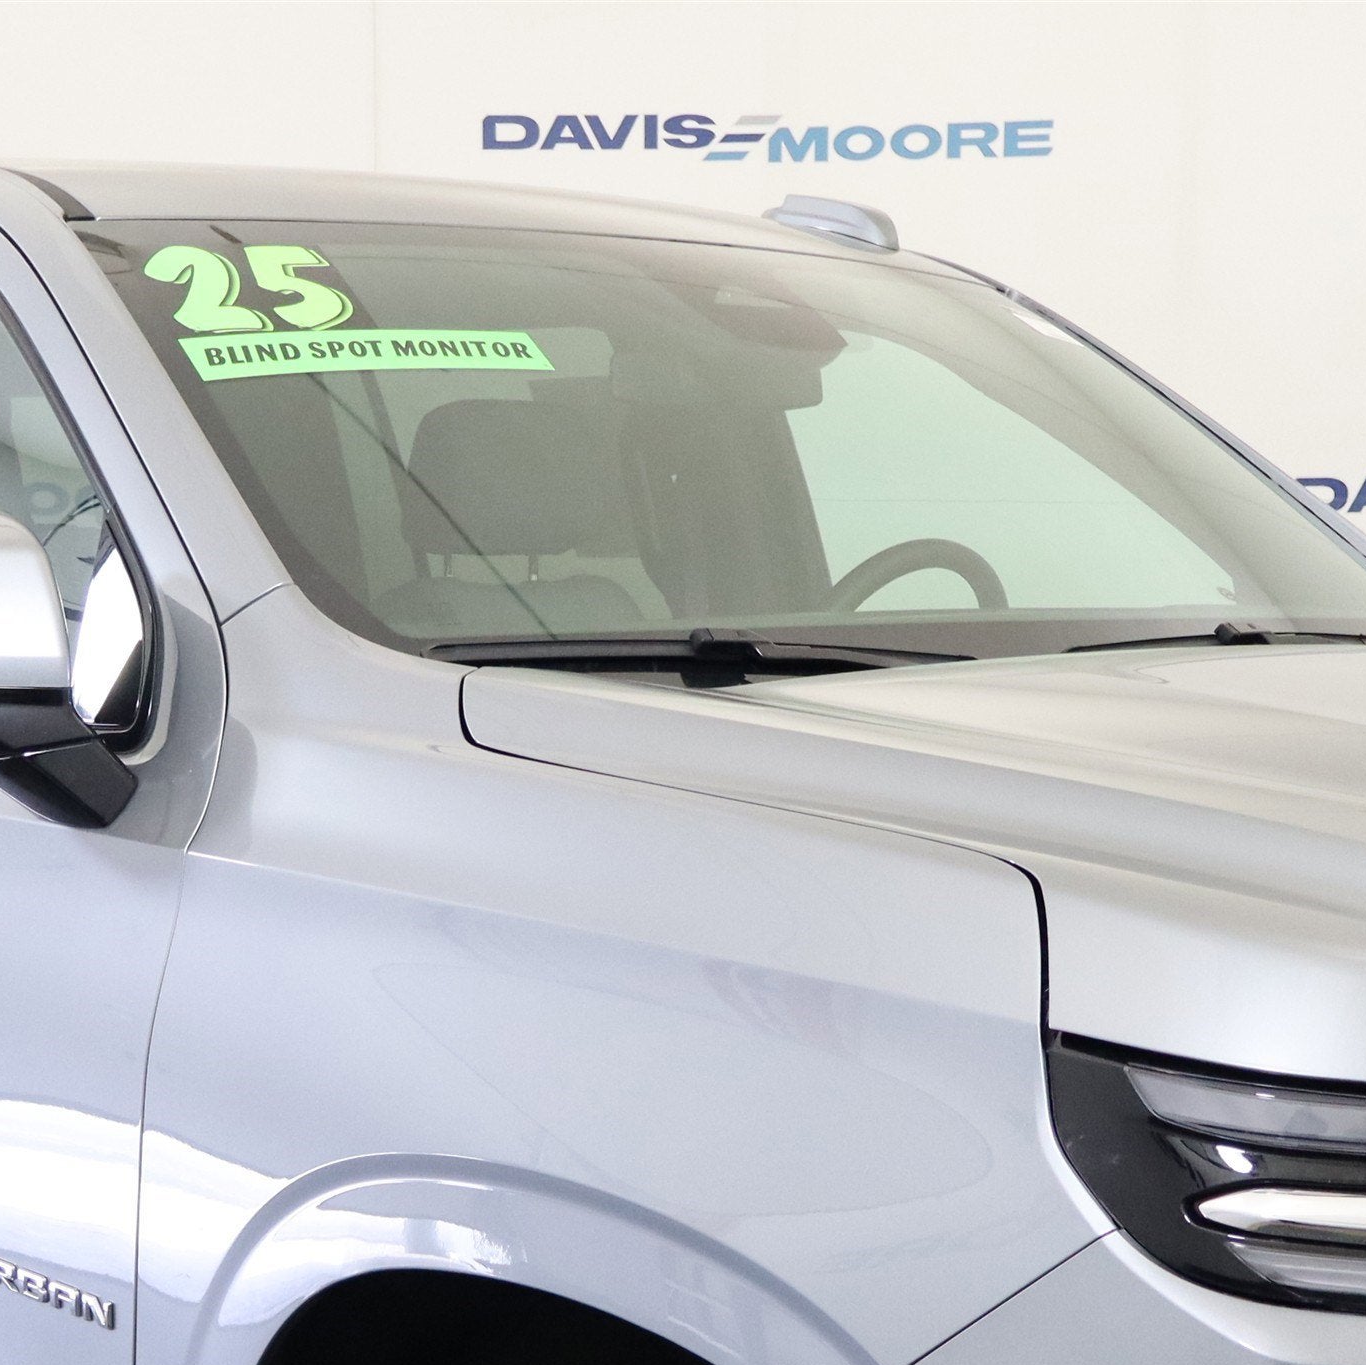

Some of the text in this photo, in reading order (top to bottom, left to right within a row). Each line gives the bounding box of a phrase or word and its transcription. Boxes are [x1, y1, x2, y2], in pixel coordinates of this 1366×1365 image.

[483, 114, 1053, 162] DAVIS MOORE
[144, 245, 354, 332] 25
[204, 340, 533, 366] BLIND SPOT MONITOR
